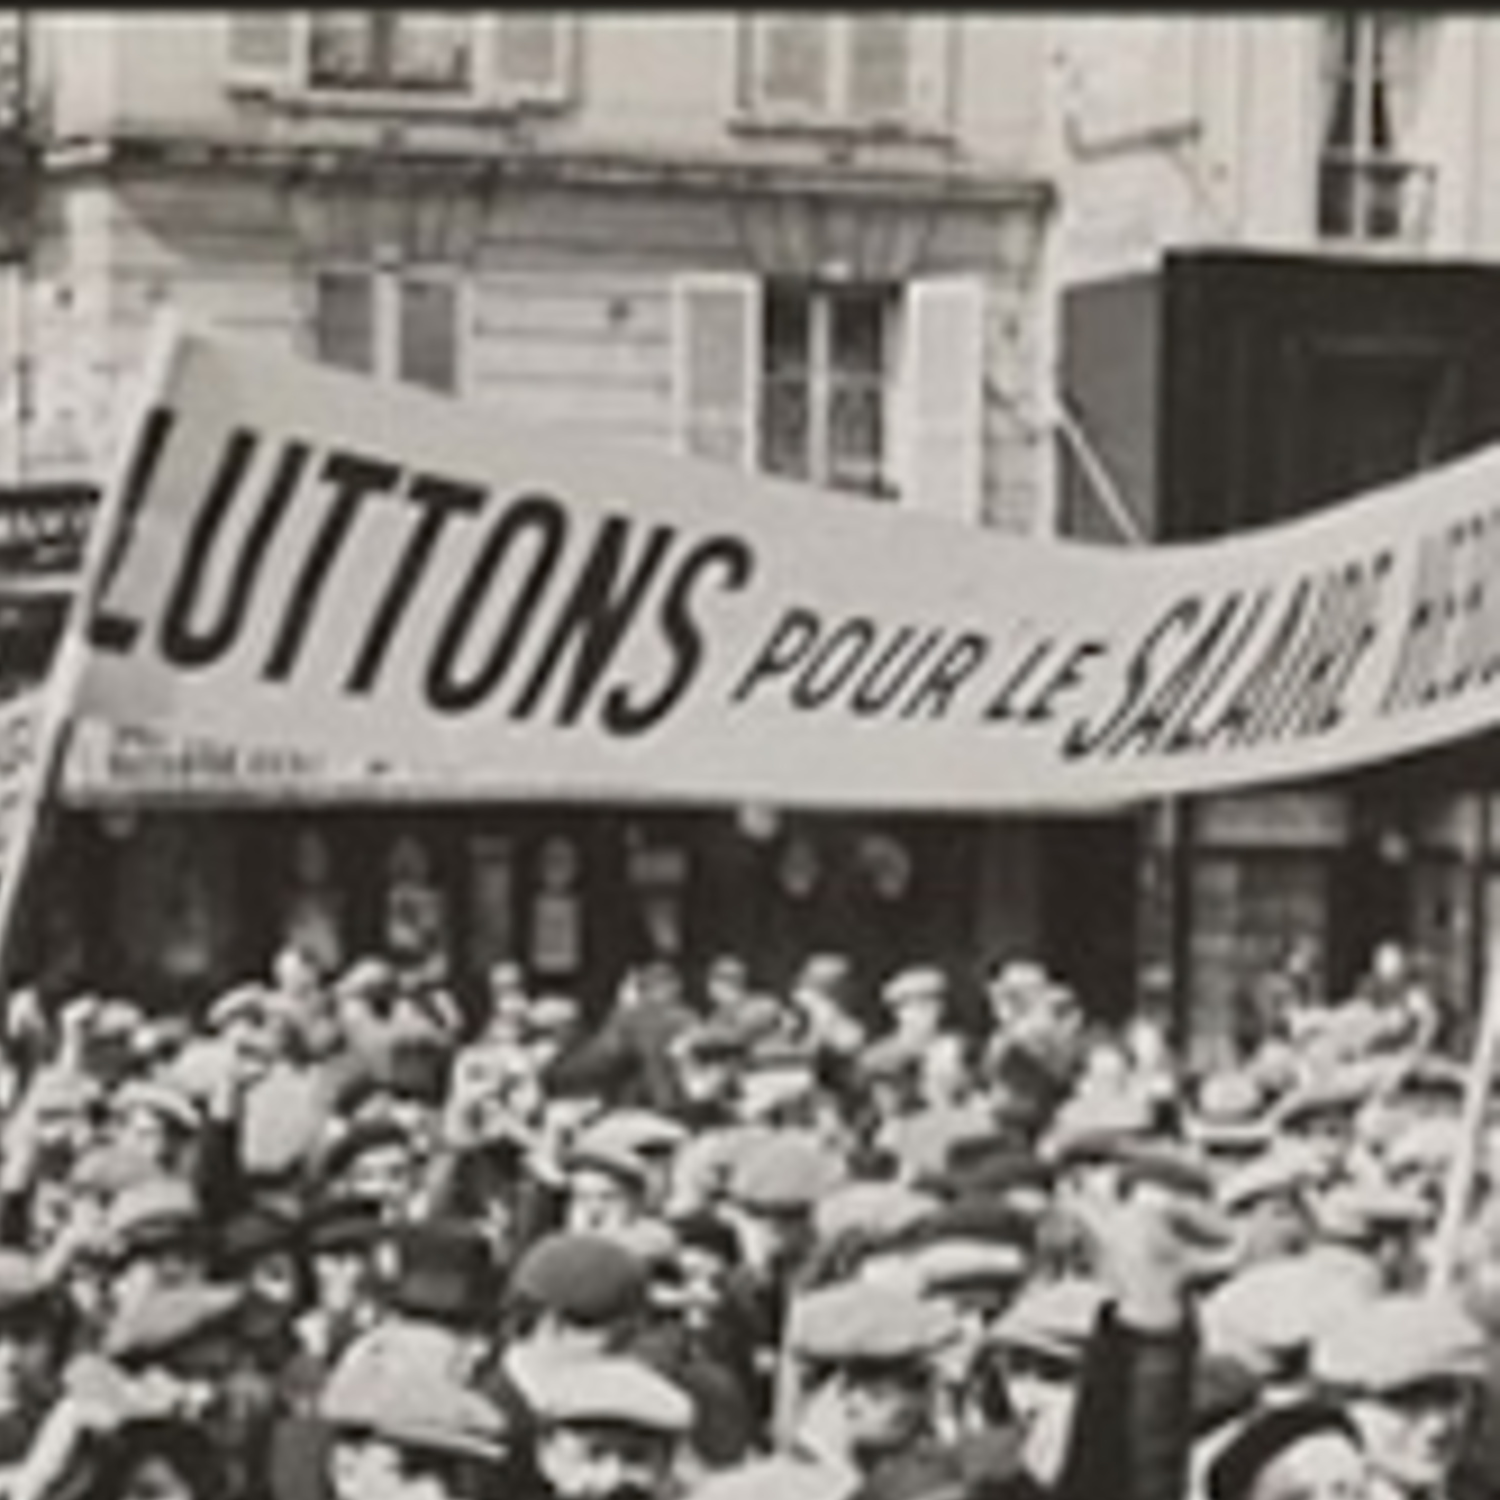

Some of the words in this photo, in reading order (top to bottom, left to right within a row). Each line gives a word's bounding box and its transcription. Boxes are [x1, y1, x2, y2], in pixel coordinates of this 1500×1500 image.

[83, 405, 757, 738] LUTTONS
[732, 605, 990, 720] POUR
[983, 636, 1106, 722] LE
